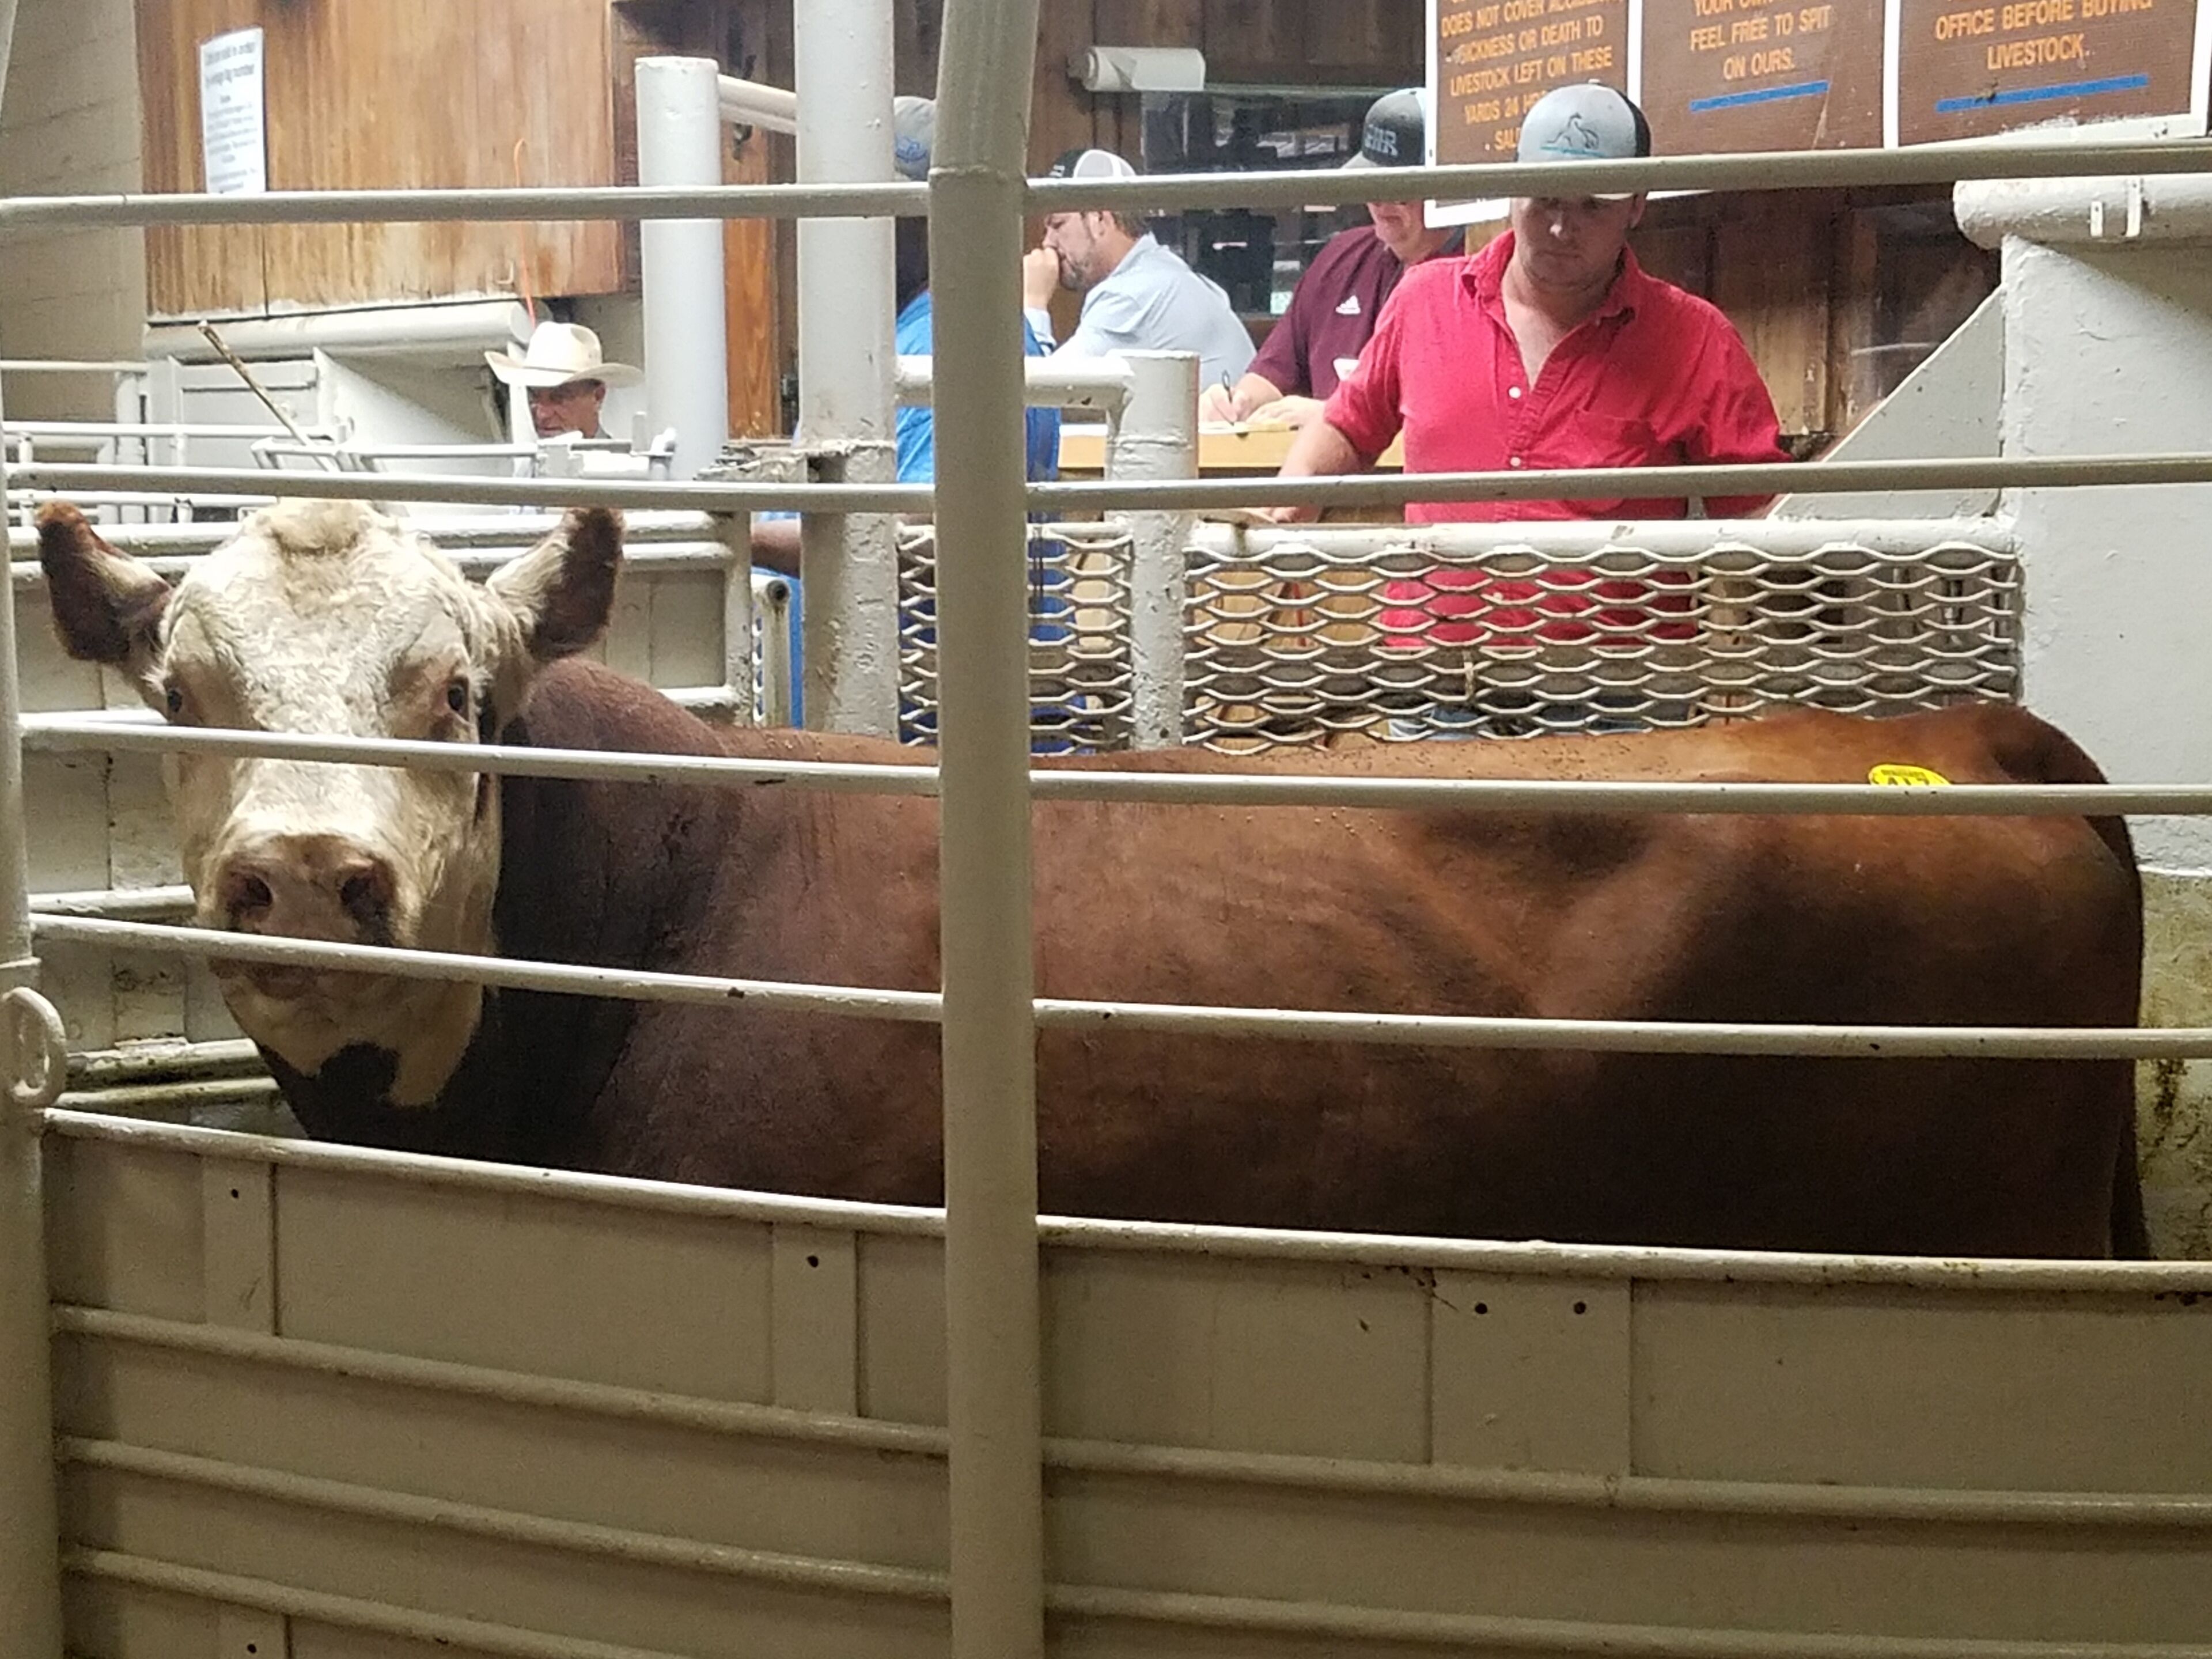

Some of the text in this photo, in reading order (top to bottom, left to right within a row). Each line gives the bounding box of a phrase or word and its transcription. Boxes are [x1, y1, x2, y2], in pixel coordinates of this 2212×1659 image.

[1441, 12, 1473, 38] DOES
[1476, 5, 1500, 29] NOT
[1503, 0, 1544, 22] COVER
[1518, 29, 1538, 51] OR
[1541, 20, 1581, 46] DEATH
[1585, 14, 1604, 37] TO
[1690, 5, 1832, 52] FEEL FREE TO SPIT
[1935, 8, 1995, 40] OFFICE
[2002, 0, 2074, 30] BEFORE
[1450, 46, 1613, 97] LIVESTOCK LEFT ON THESE
[1723, 47, 1795, 80] ON OURS.
[1464, 100, 1501, 125] YARDS
[1504, 95, 1520, 118] 24
